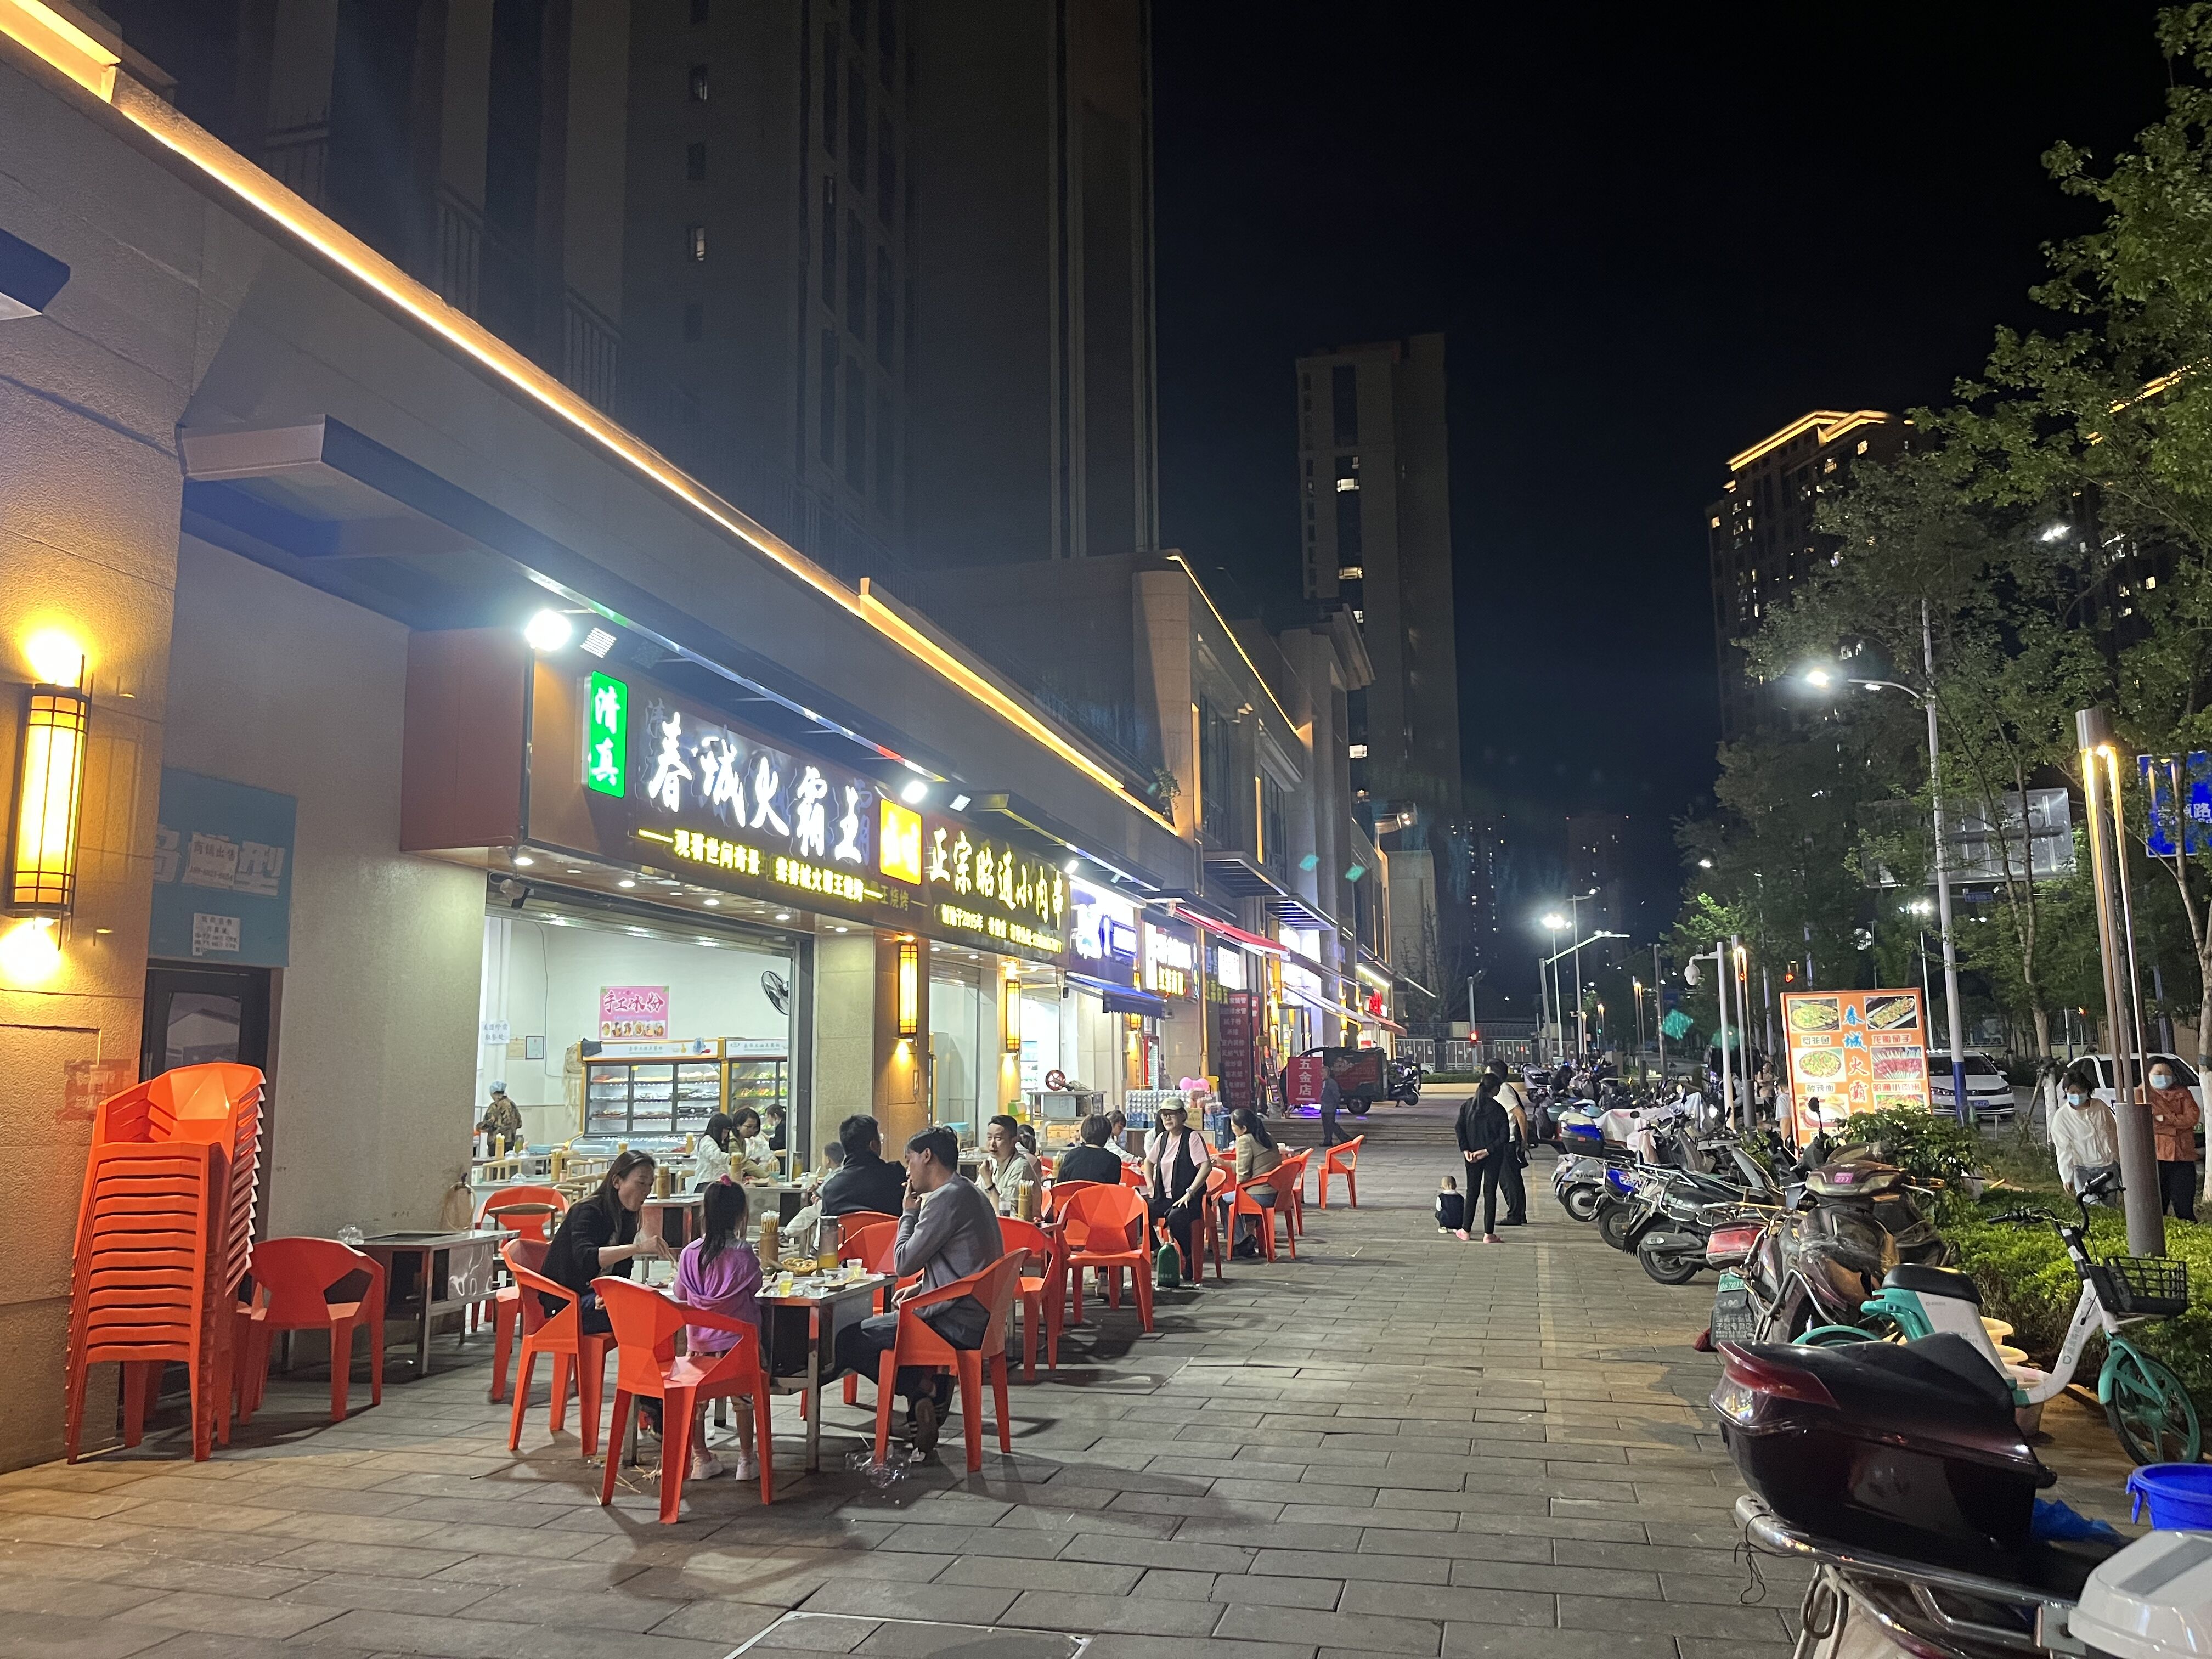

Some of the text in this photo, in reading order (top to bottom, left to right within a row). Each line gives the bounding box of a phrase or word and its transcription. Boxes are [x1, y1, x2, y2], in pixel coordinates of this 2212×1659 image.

[591, 685, 620, 786] 清真
[929, 827, 1064, 930] 正宗昭通小肉串
[603, 990, 664, 1014] 手工冰粉
[1299, 1059, 1312, 1096] 五金店
[1842, 1005, 1870, 1113] 春城火霸
